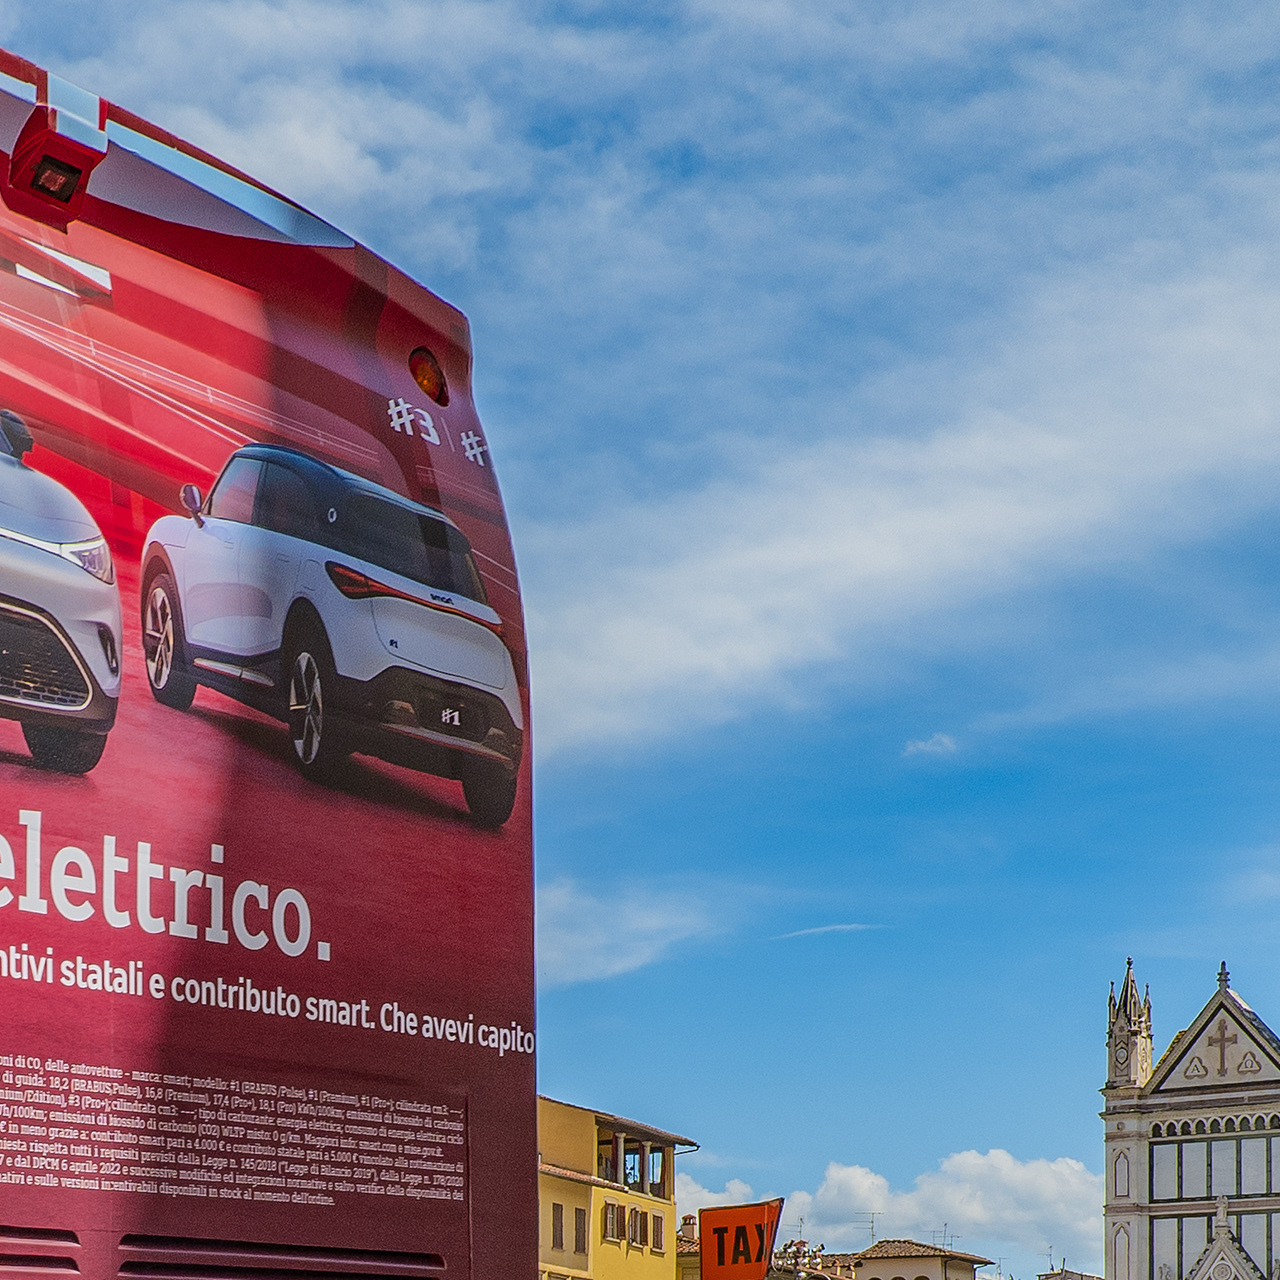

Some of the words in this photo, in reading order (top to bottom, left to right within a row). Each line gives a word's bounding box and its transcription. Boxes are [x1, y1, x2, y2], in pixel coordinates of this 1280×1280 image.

[387, 398, 441, 446] #3
[60, 955, 143, 996] statali
[149, 973, 165, 999] e
[171, 976, 301, 1019] contributo
[305, 996, 375, 1030] smart.
[380, 1003, 418, 1035] Che
[422, 1014, 474, 1044] avevi
